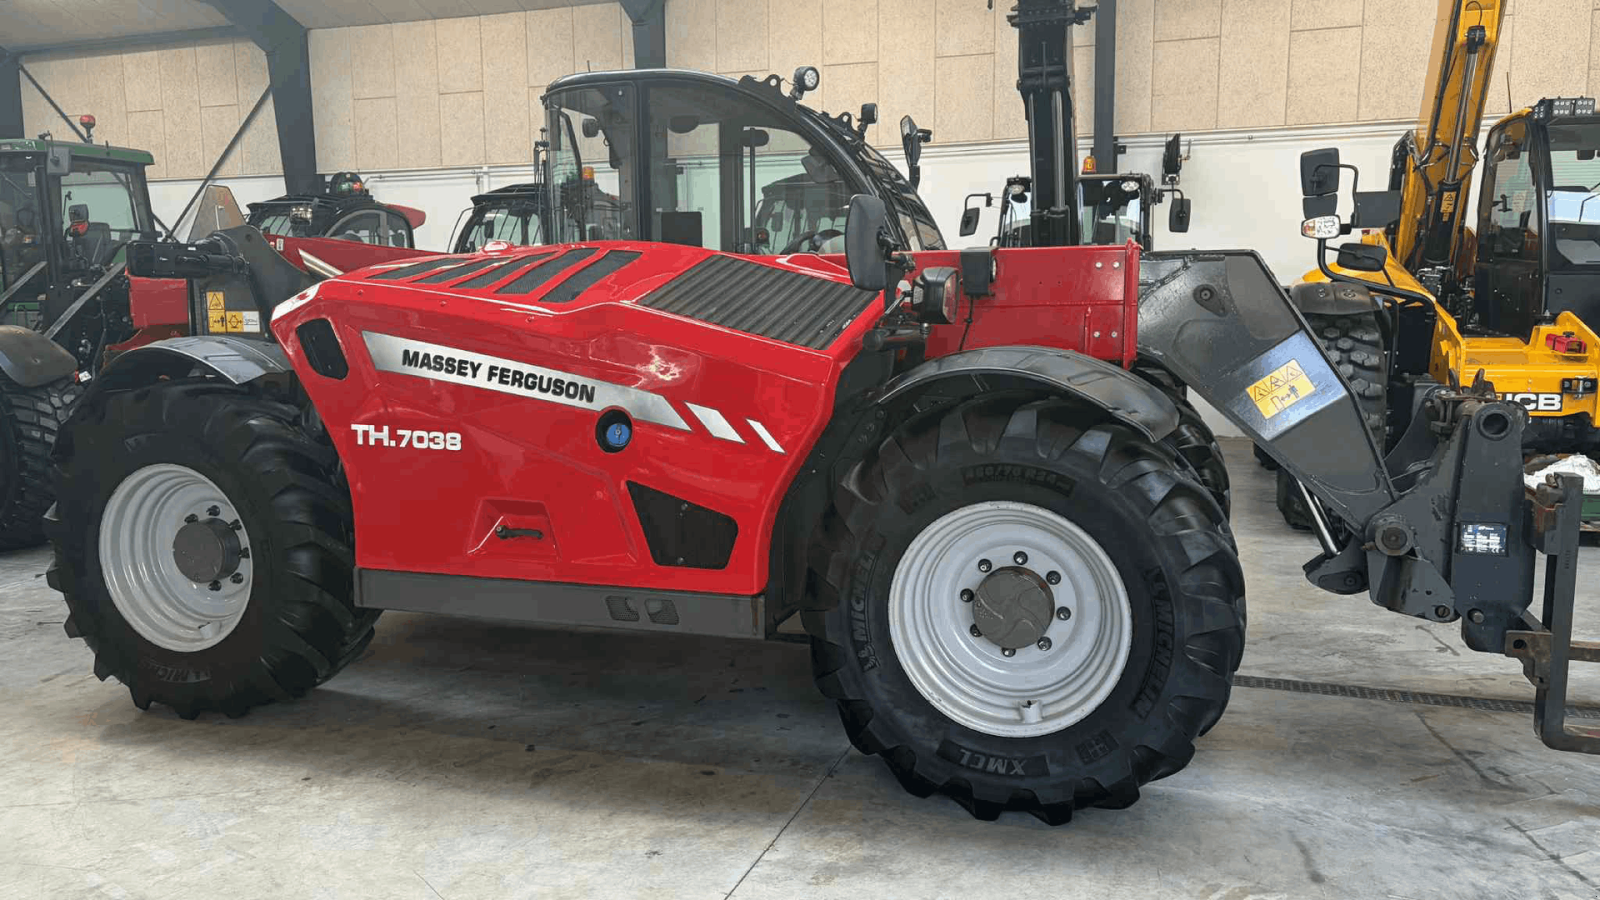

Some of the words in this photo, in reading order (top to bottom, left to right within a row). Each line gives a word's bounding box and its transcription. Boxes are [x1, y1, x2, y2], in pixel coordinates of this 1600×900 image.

[402, 349, 483, 379] MASSEY
[487, 365, 596, 403] FERGUSON
[351, 423, 462, 451] TH.7038
[850, 543, 879, 642] MICHELI
[1133, 599, 1175, 718] MICHELIN
[959, 748, 1028, 775] XMCL
